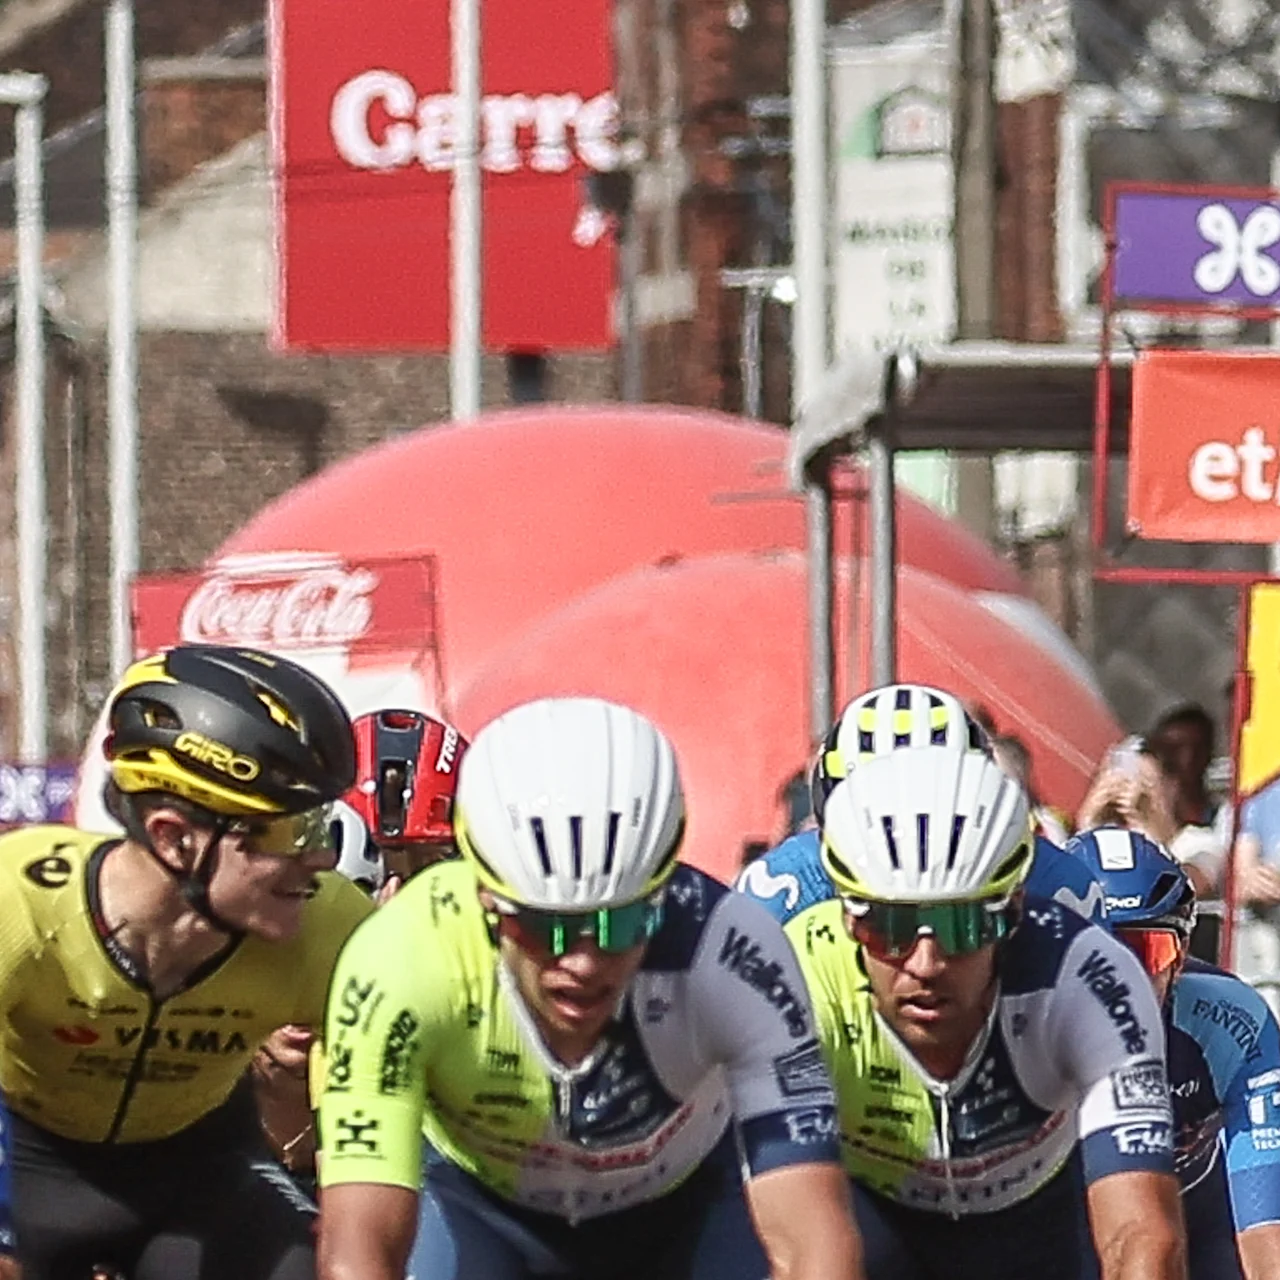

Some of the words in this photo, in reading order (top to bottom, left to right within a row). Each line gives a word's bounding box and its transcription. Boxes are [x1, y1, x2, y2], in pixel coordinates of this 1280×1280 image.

[174, 732, 260, 782] GIRO
[718, 926, 807, 1039] Wallonie
[1077, 949, 1148, 1056] Wallonie
[114, 1025, 248, 1053] VISMA
[1192, 998, 1264, 1064] FANTINI
